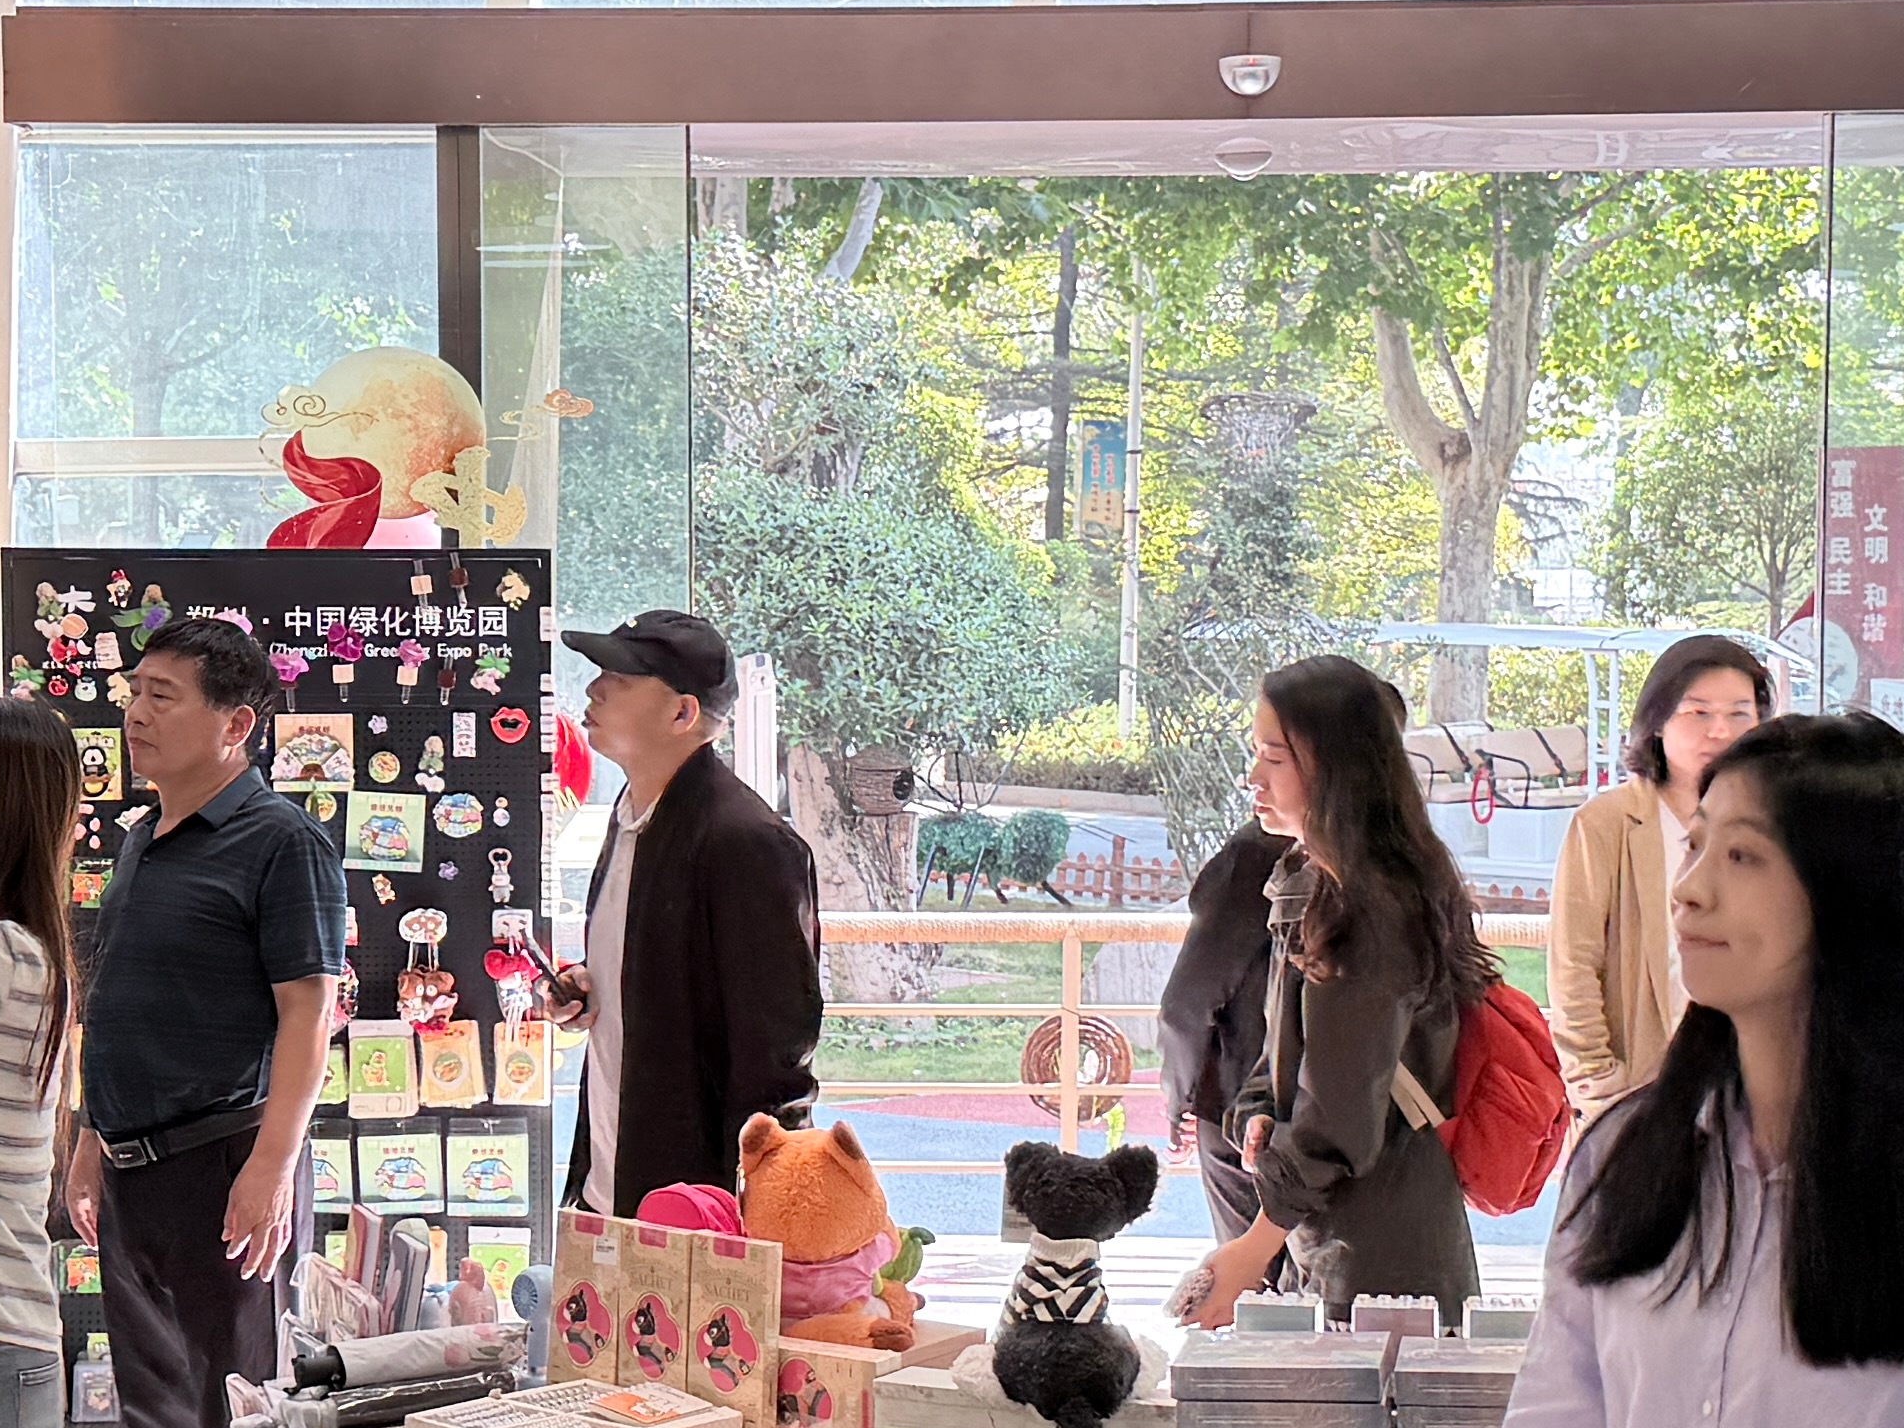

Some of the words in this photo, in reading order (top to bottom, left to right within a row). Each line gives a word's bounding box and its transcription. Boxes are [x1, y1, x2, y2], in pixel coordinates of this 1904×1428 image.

[1830, 459, 1856, 519] 富强
[1863, 503, 1889, 564] 文明
[1826, 536, 1854, 596] 民主
[1862, 582, 1888, 643] 和谐
[437, 643, 472, 661] Expo
